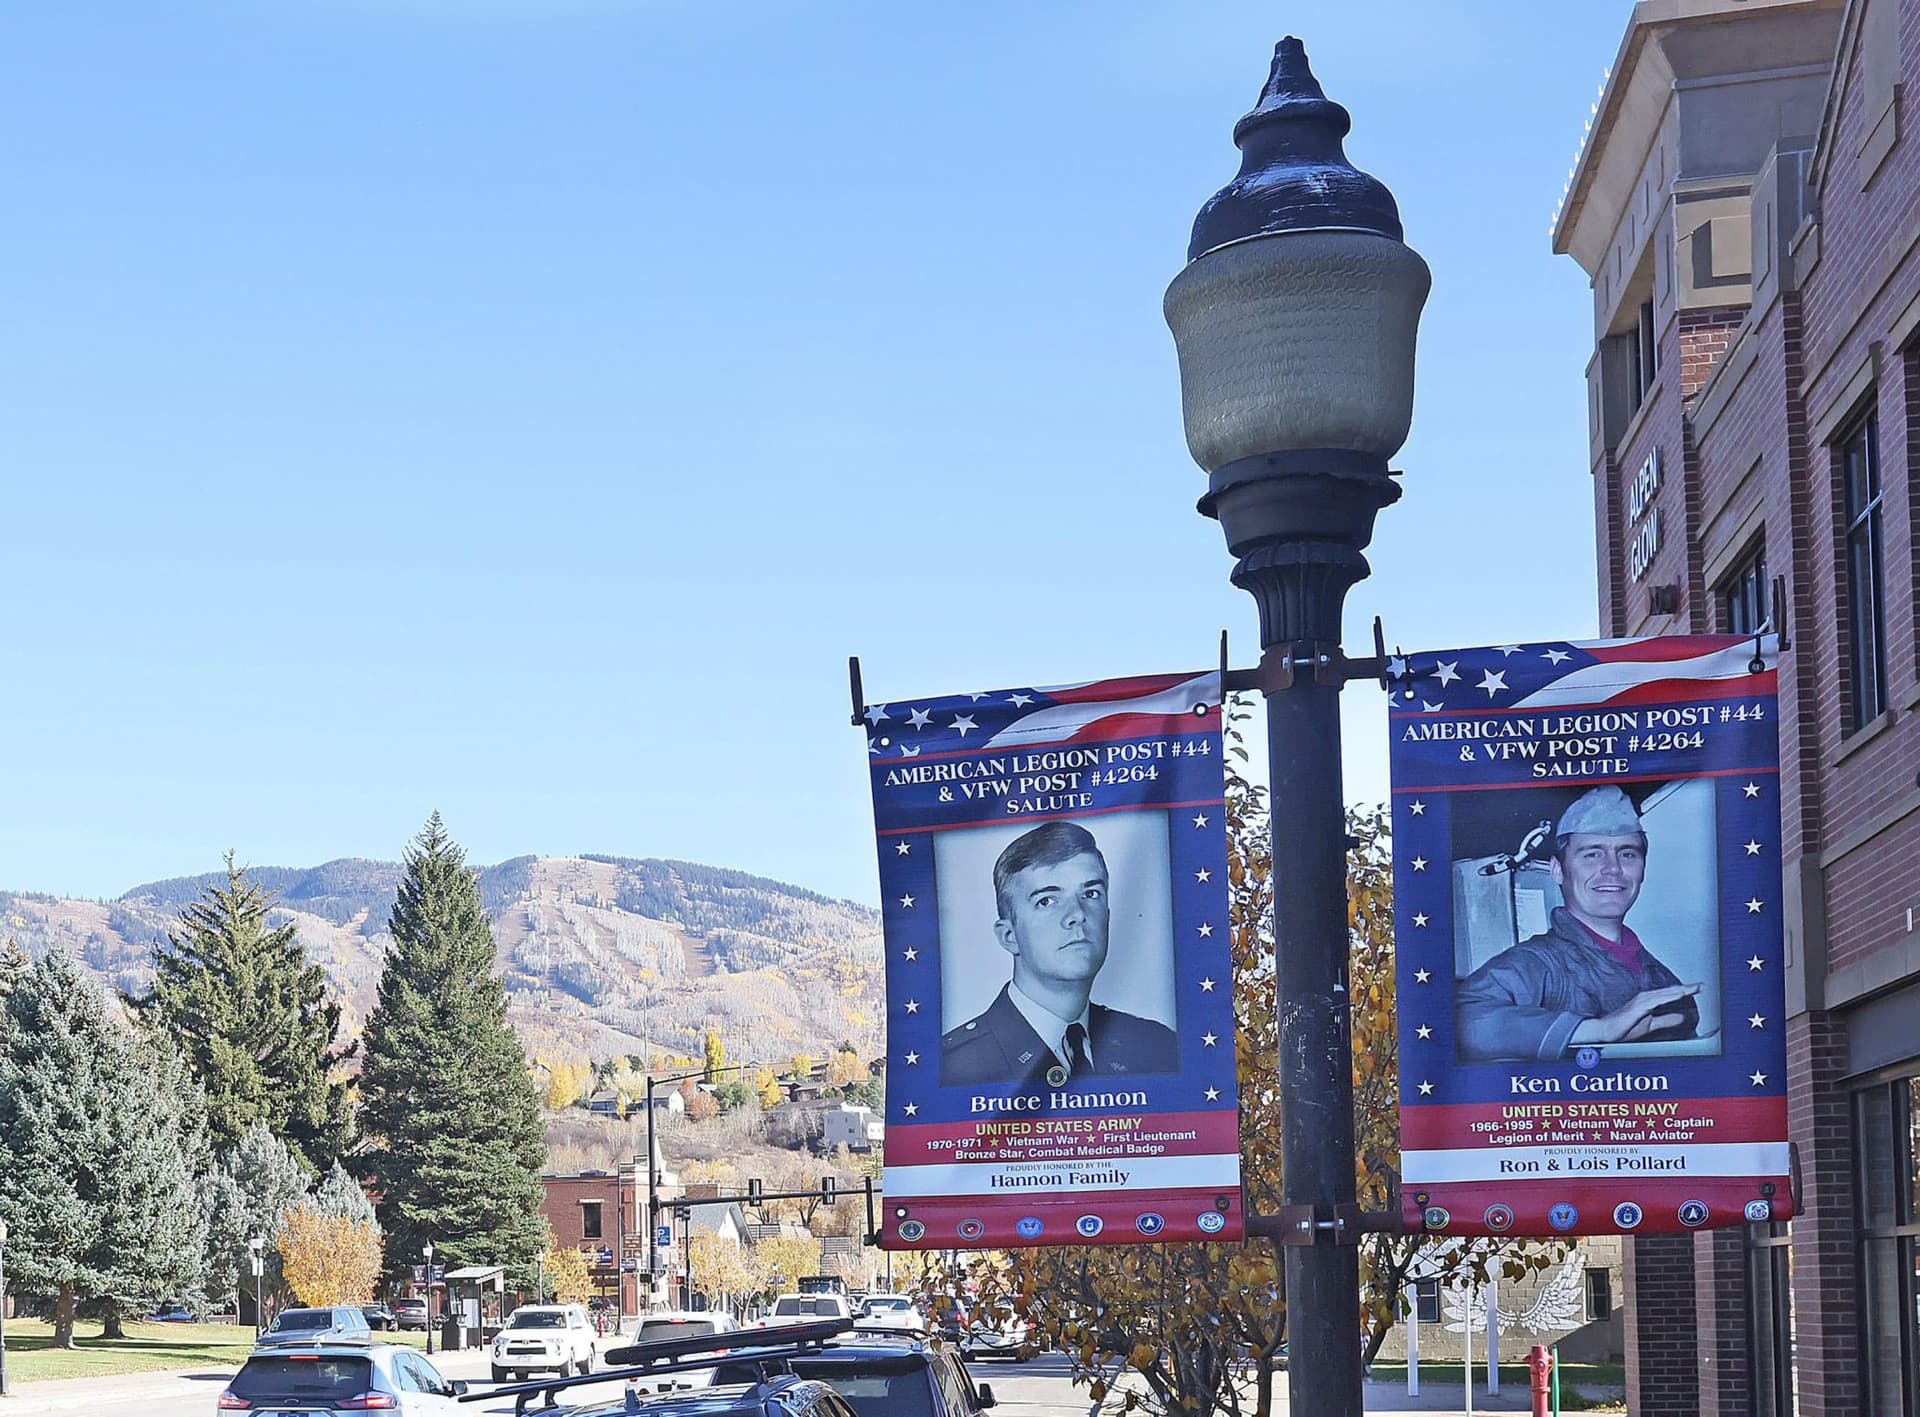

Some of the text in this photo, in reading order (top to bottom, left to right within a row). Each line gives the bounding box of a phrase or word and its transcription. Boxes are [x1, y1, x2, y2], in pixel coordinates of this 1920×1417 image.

[1629, 445, 1658, 528] ALPEN
[1631, 507, 1658, 583] GLOW
[1402, 703, 1764, 741] AMERICAN LEGION POST #44
[1459, 730, 1705, 761] & VFW POST #4264
[885, 740, 1211, 786] AMERICAN LEGION POST #44
[1533, 758, 1629, 778] SALUTE
[939, 765, 1159, 802] & VFW POST #4264
[1007, 793, 1093, 814] SALUTE
[1510, 1071, 1669, 1094] Ken Carlton
[970, 1089, 1147, 1112] Bruce Hannon
[1502, 1103, 1680, 1118] UNITED STATES NAVY
[975, 1118, 1142, 1135] UNITED STATES ARMY
[1470, 1116, 1714, 1132] 1966-1995 Vietnam War Captain
[926, 1130, 1196, 1150] 1970-1971 Vietnam War First Lieutenant
[1489, 1129, 1694, 1144] Legion of Merit Naval Aviator
[955, 1143, 1164, 1160] Bronze Star, Combat Medical Badge
[1544, 1147, 1584, 1155] PROUDLY
[1499, 1155, 1686, 1173] Ron & Lois Pollard
[991, 1168, 1130, 1188] Hannon Family
